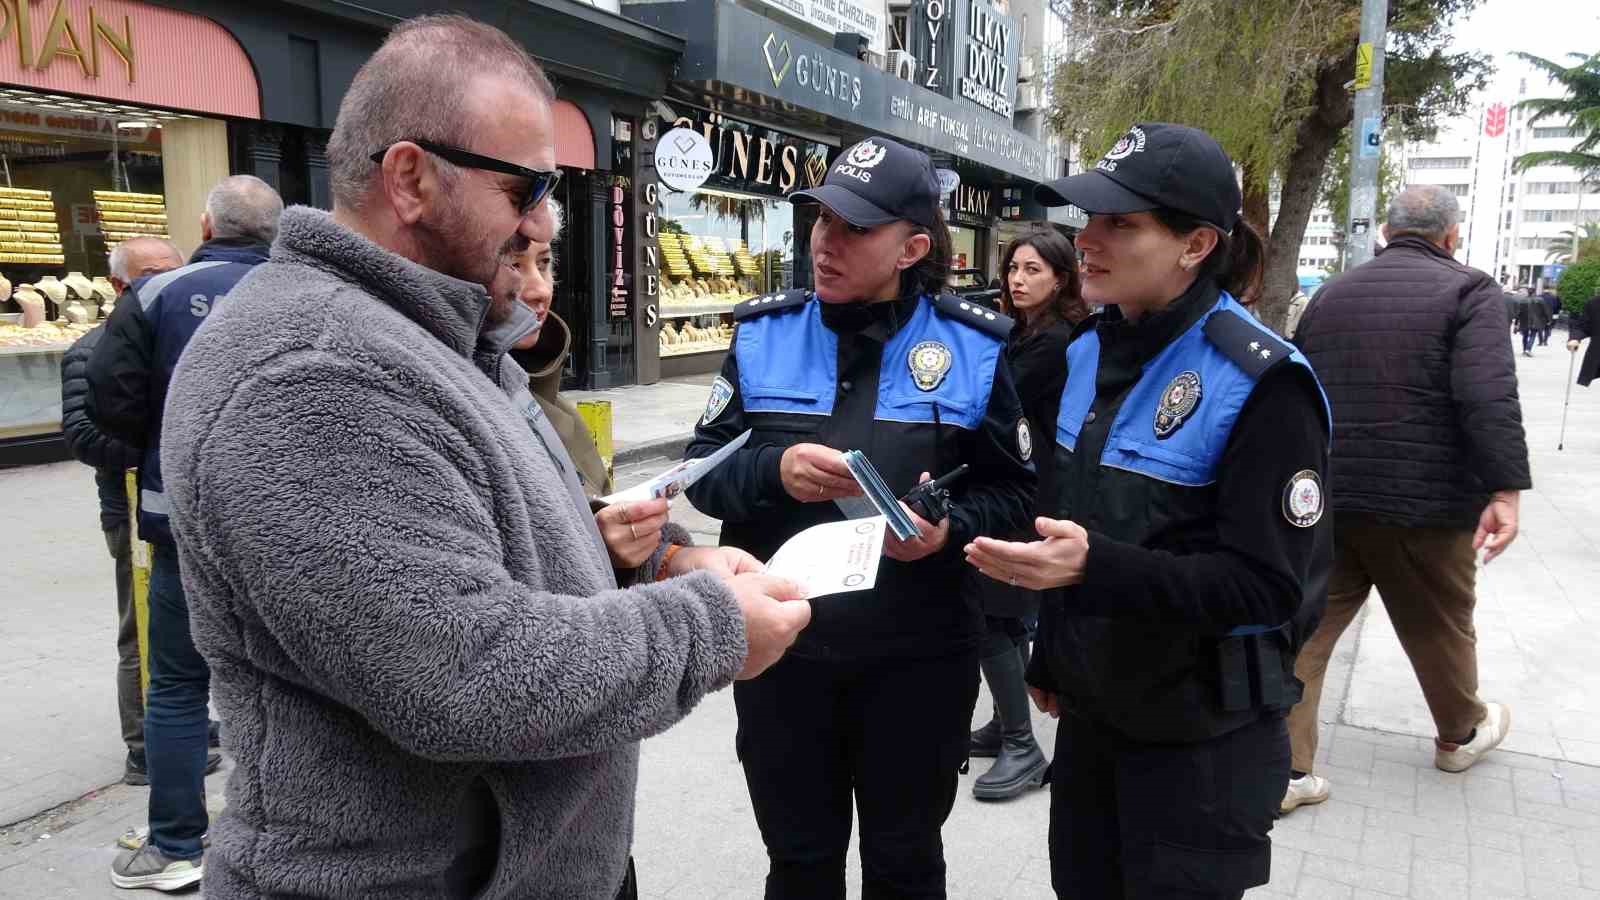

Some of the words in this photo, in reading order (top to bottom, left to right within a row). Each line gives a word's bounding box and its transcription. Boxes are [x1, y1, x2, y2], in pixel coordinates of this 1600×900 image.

[796, 51, 861, 112] GÜNEŞ
[673, 112, 797, 193] ÜNEŞ
[646, 183, 657, 328] GÜNEŞ
